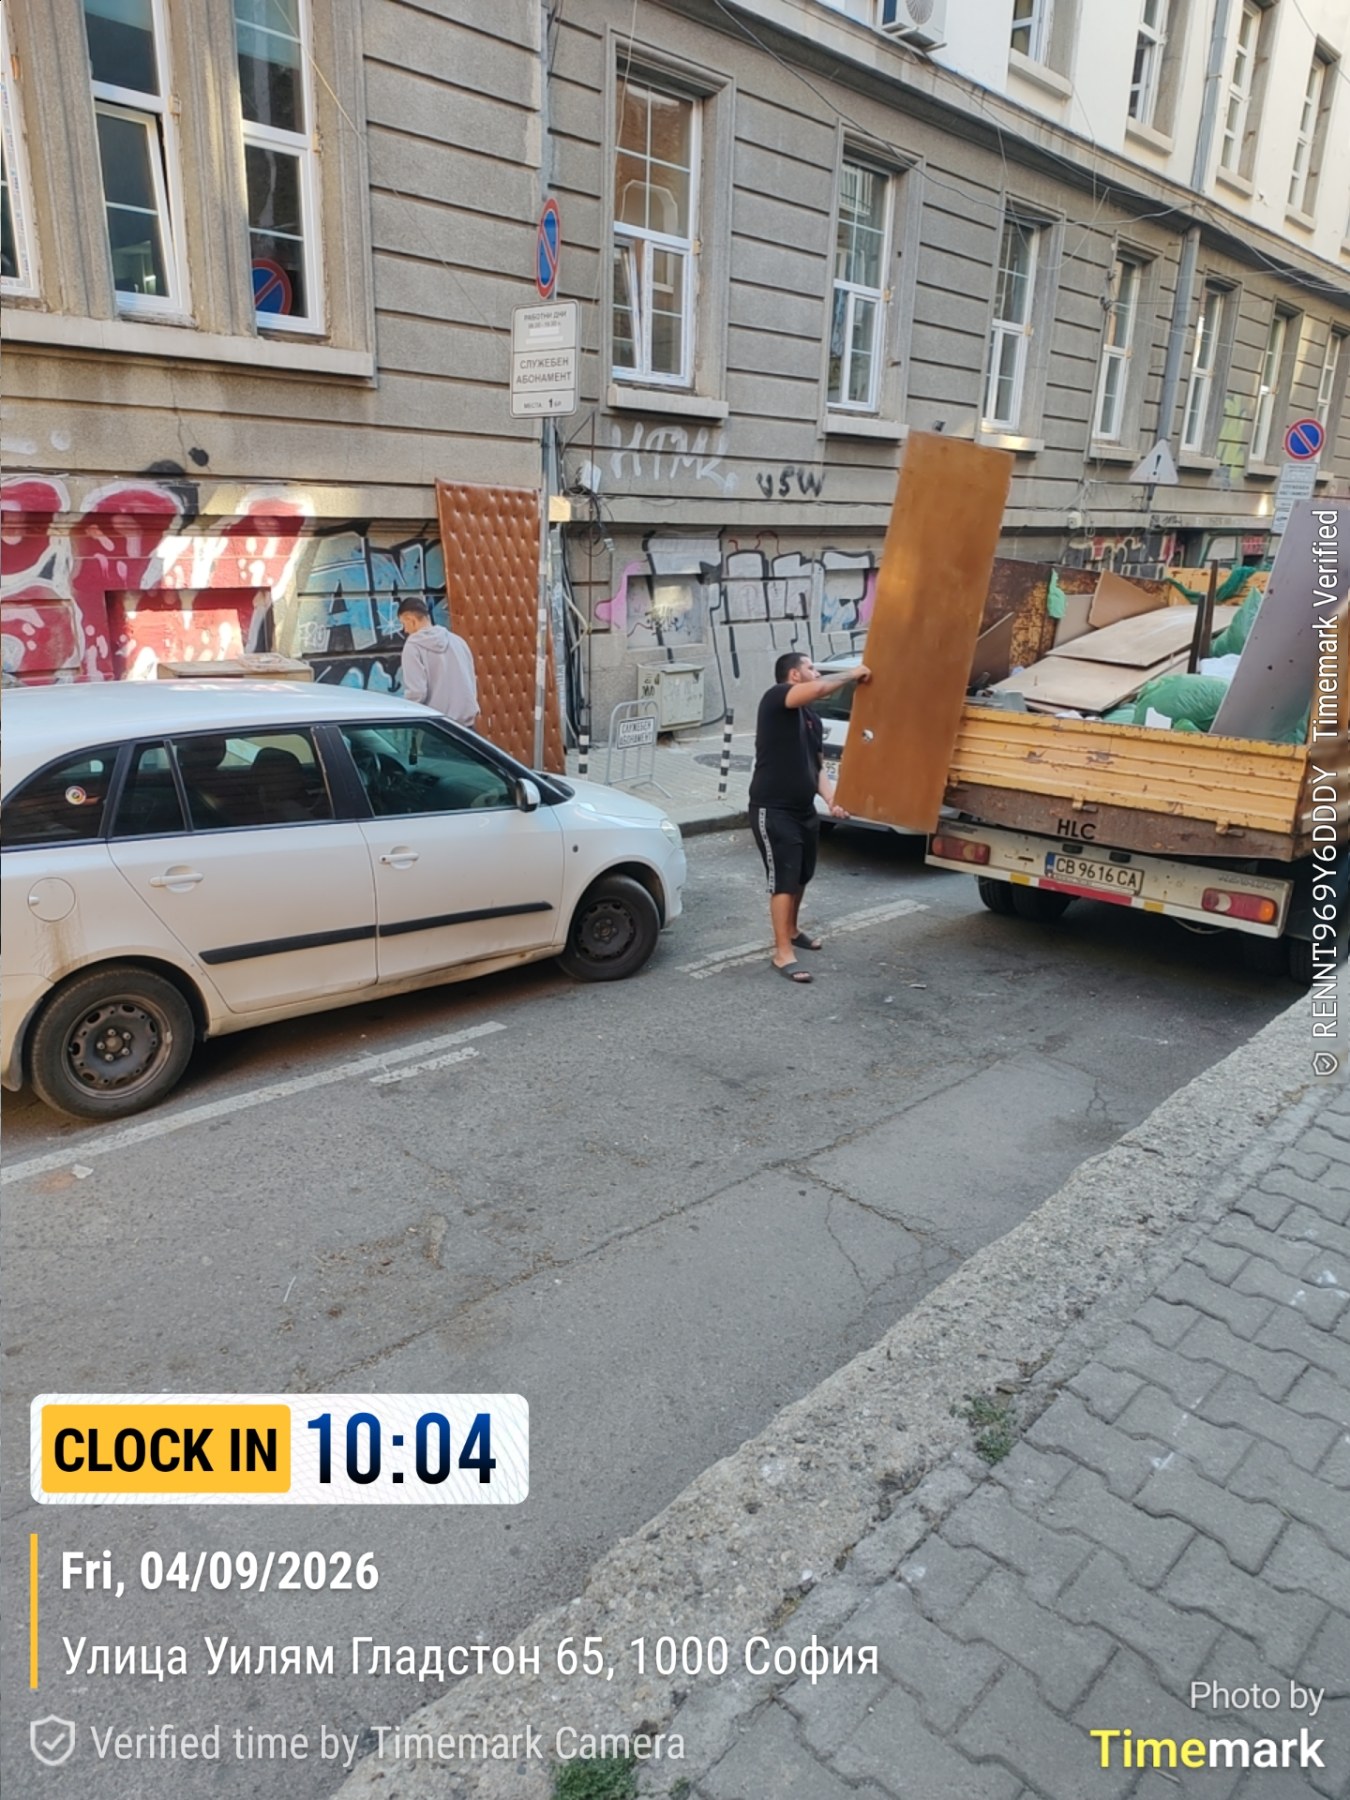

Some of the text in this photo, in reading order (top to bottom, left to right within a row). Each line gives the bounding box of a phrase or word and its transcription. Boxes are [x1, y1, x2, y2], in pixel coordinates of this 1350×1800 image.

[520, 356, 569, 369] СЛУЖЕБЕН
[516, 371, 572, 384] АБОНАМЕНТ
[1057, 818, 1096, 840] HLC
[1056, 858, 1075, 874] CB
[1079, 862, 1114, 882] 9616
[1117, 870, 1136, 888] CA
